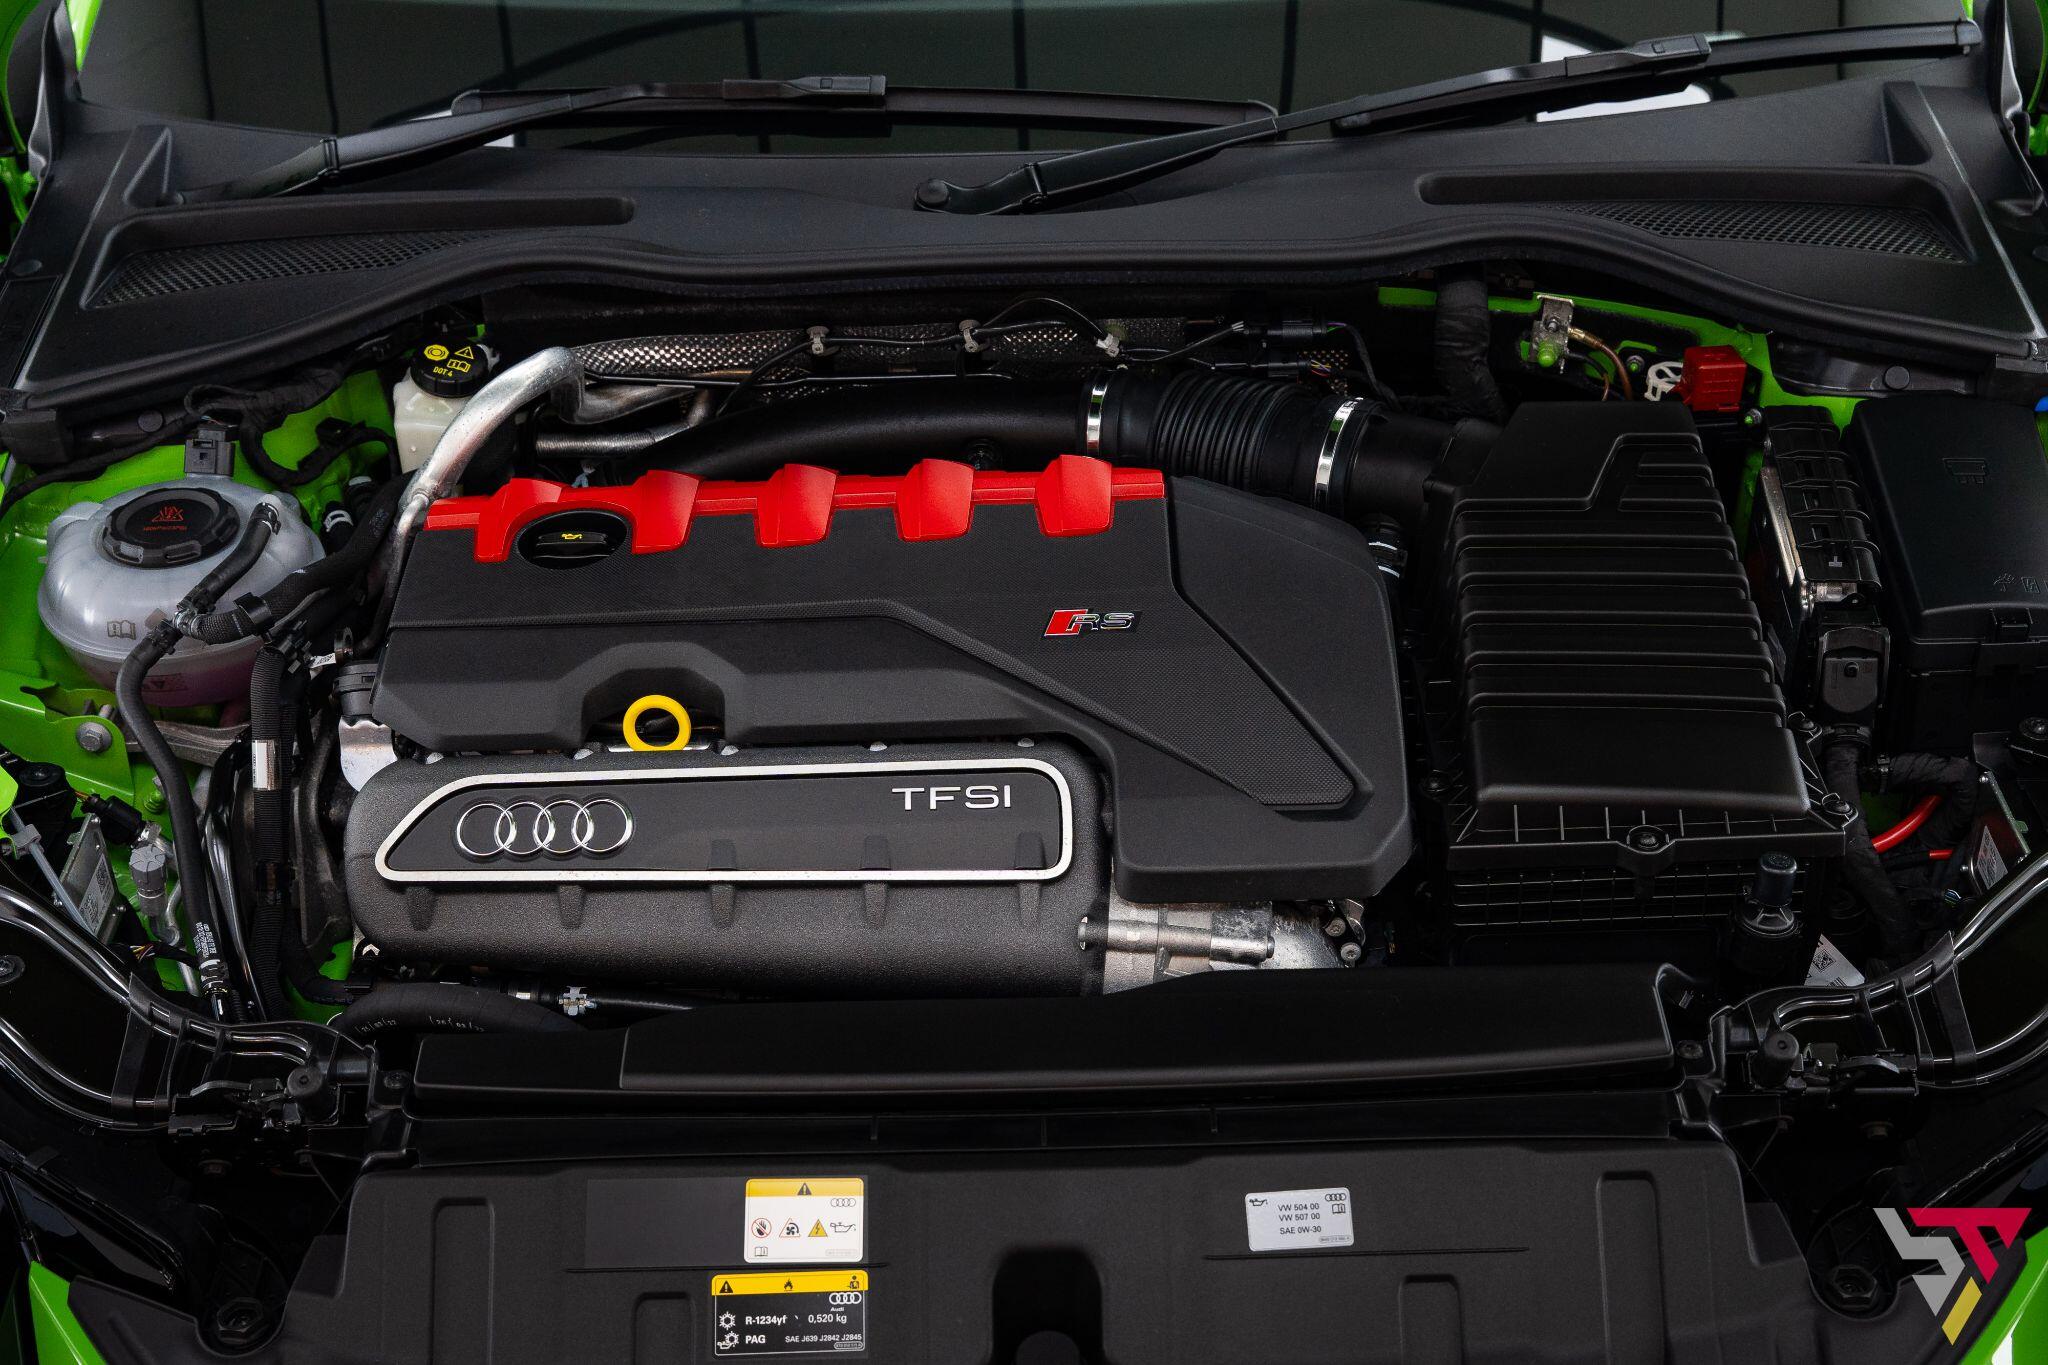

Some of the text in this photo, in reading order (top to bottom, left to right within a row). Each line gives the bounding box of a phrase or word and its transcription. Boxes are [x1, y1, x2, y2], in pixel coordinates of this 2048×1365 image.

[433, 366, 447, 375] DOT
[1064, 611, 1135, 631] RS
[891, 784, 1011, 811] TFSI
[1294, 1203, 1308, 1211] 504
[1310, 1202, 1319, 1210] 00
[1295, 1213, 1308, 1221] 507
[1311, 1212, 1320, 1220] 00
[1280, 1225, 1322, 1235] SAE 0W-30
[745, 1313, 847, 1326] R-1234yf 0,520 kg
[745, 1333, 863, 1344] PAG SAE J639 J2842 J2845
